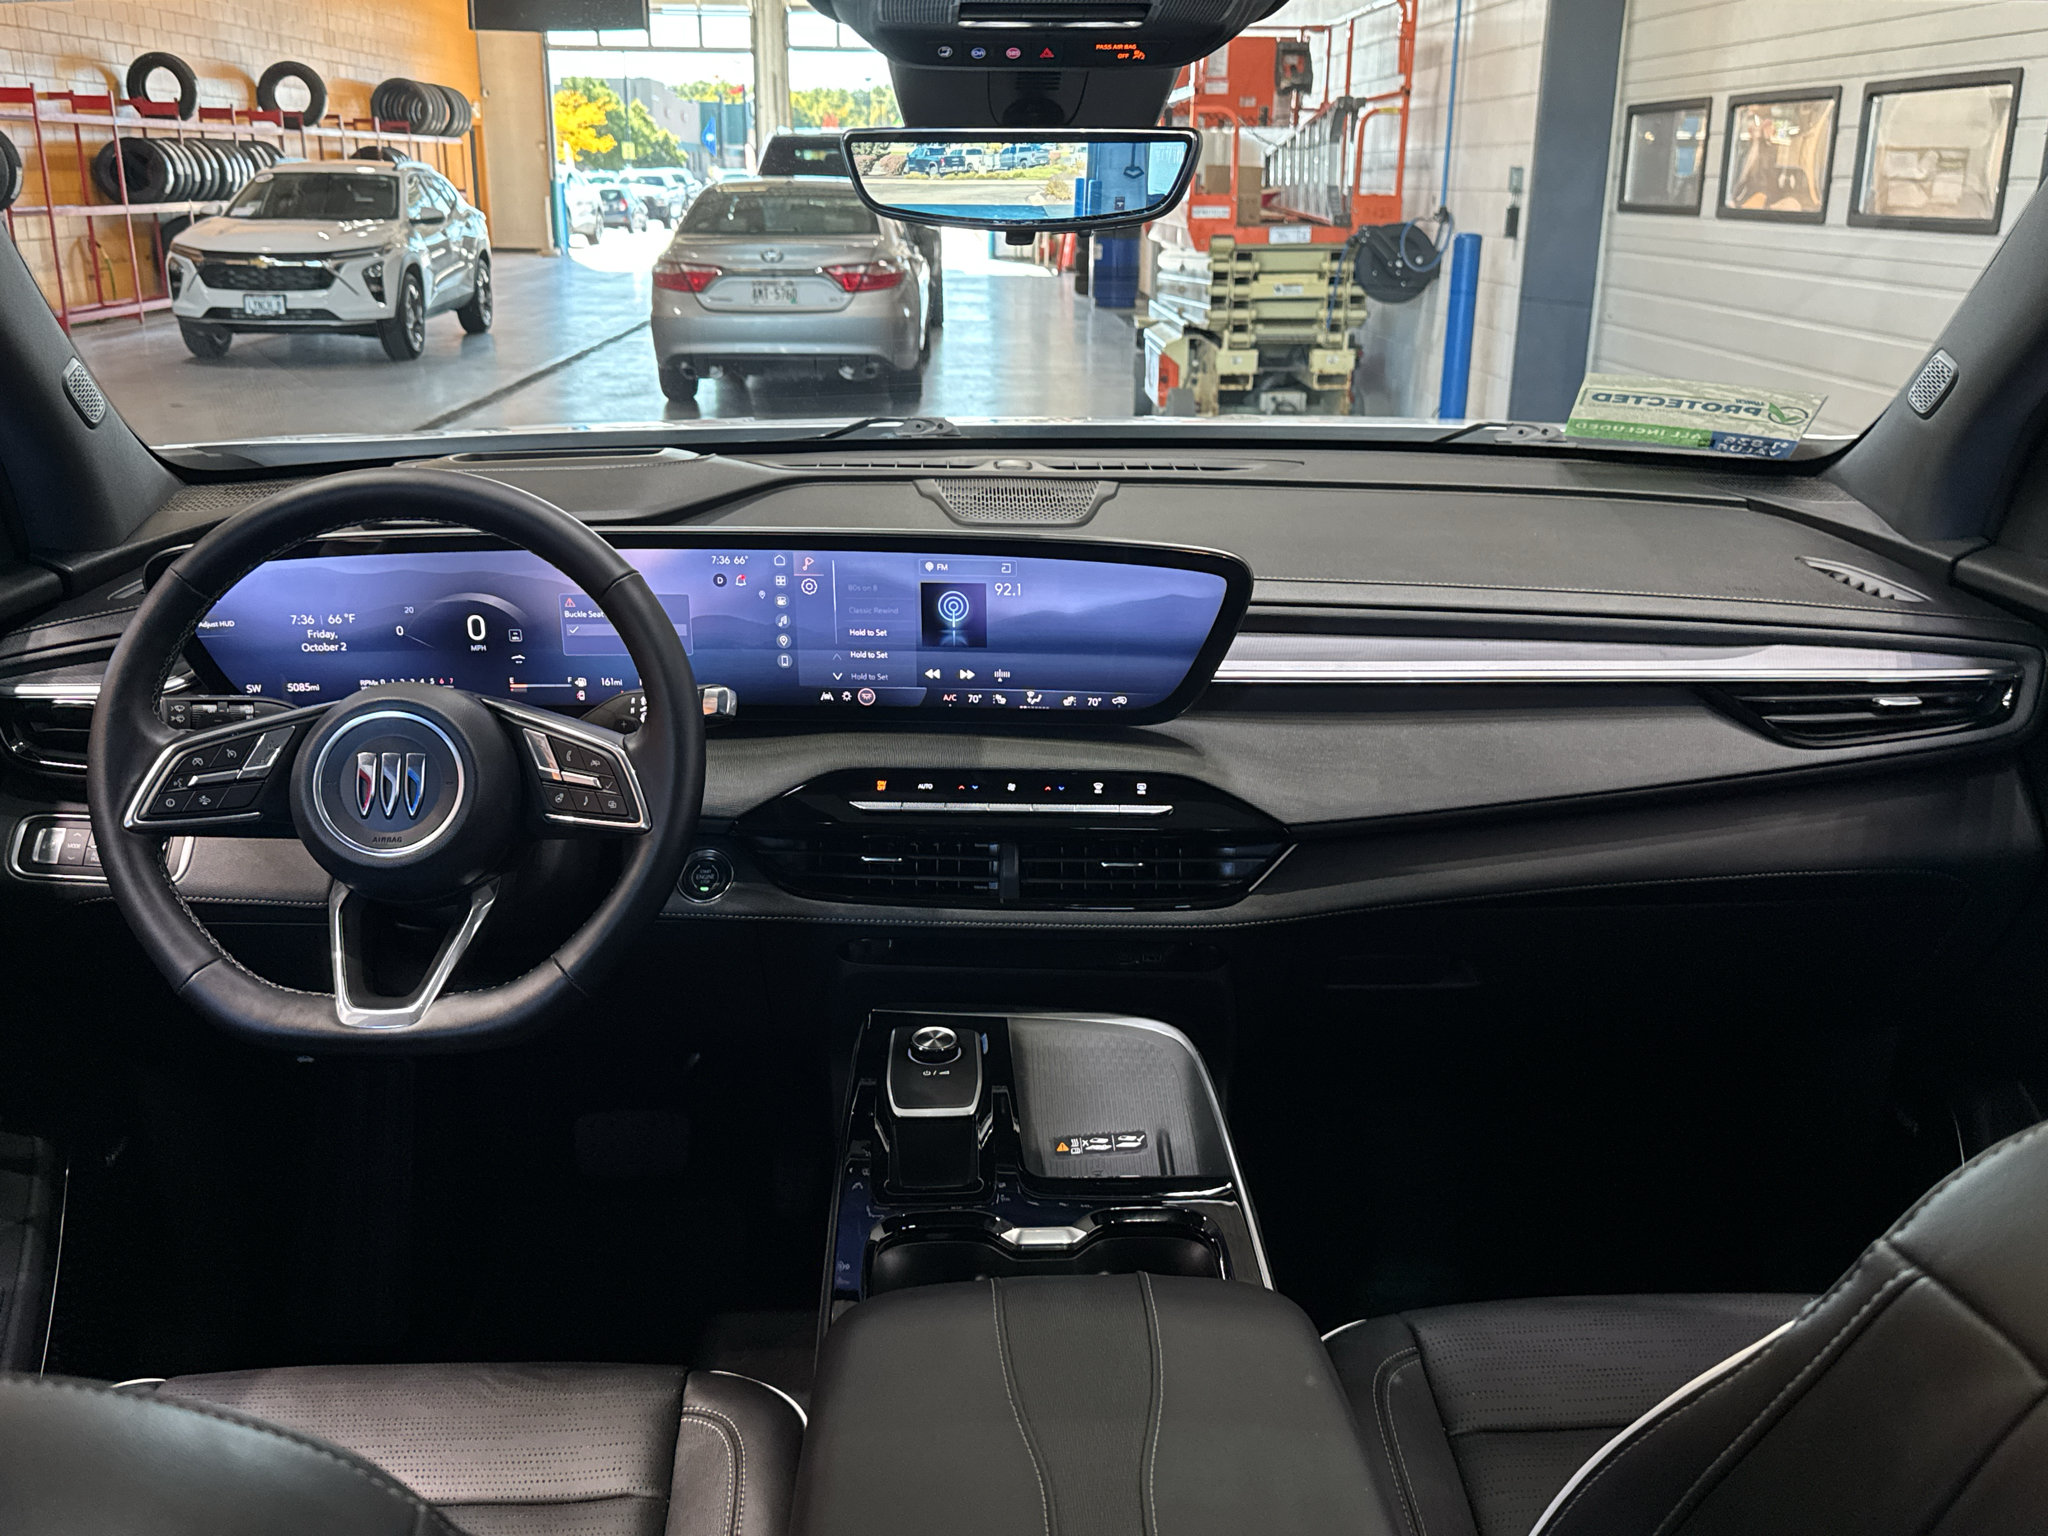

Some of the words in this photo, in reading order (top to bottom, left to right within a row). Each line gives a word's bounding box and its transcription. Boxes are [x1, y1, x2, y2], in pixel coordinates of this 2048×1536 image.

[711, 555, 731, 565] 7:36
[733, 555, 749, 565] 66°
[936, 563, 948, 571] FM
[994, 583, 1021, 597] 92.1
[404, 606, 415, 614] 20
[564, 610, 587, 618] Buckle
[588, 610, 604, 618] Seat
[290, 614, 315, 625] 7:36
[198, 621, 218, 630] Adjust
[219, 620, 235, 628] HUD
[467, 614, 486, 641] 0
[307, 629, 338, 640] Friday,
[396, 625, 404, 637] 0
[849, 628, 866, 637] Hold
[867, 629, 875, 637] to
[876, 628, 888, 637] Set
[301, 643, 339, 653] October
[340, 642, 348, 652] 2
[470, 644, 488, 652] MPH
[850, 650, 867, 659] Hold
[868, 651, 875, 659] to
[876, 650, 888, 659] Set
[601, 677, 623, 686] 161mi
[851, 673, 867, 681] Hold
[877, 673, 889, 681] Set
[245, 683, 262, 694] SW
[287, 682, 320, 692] 5085mi
